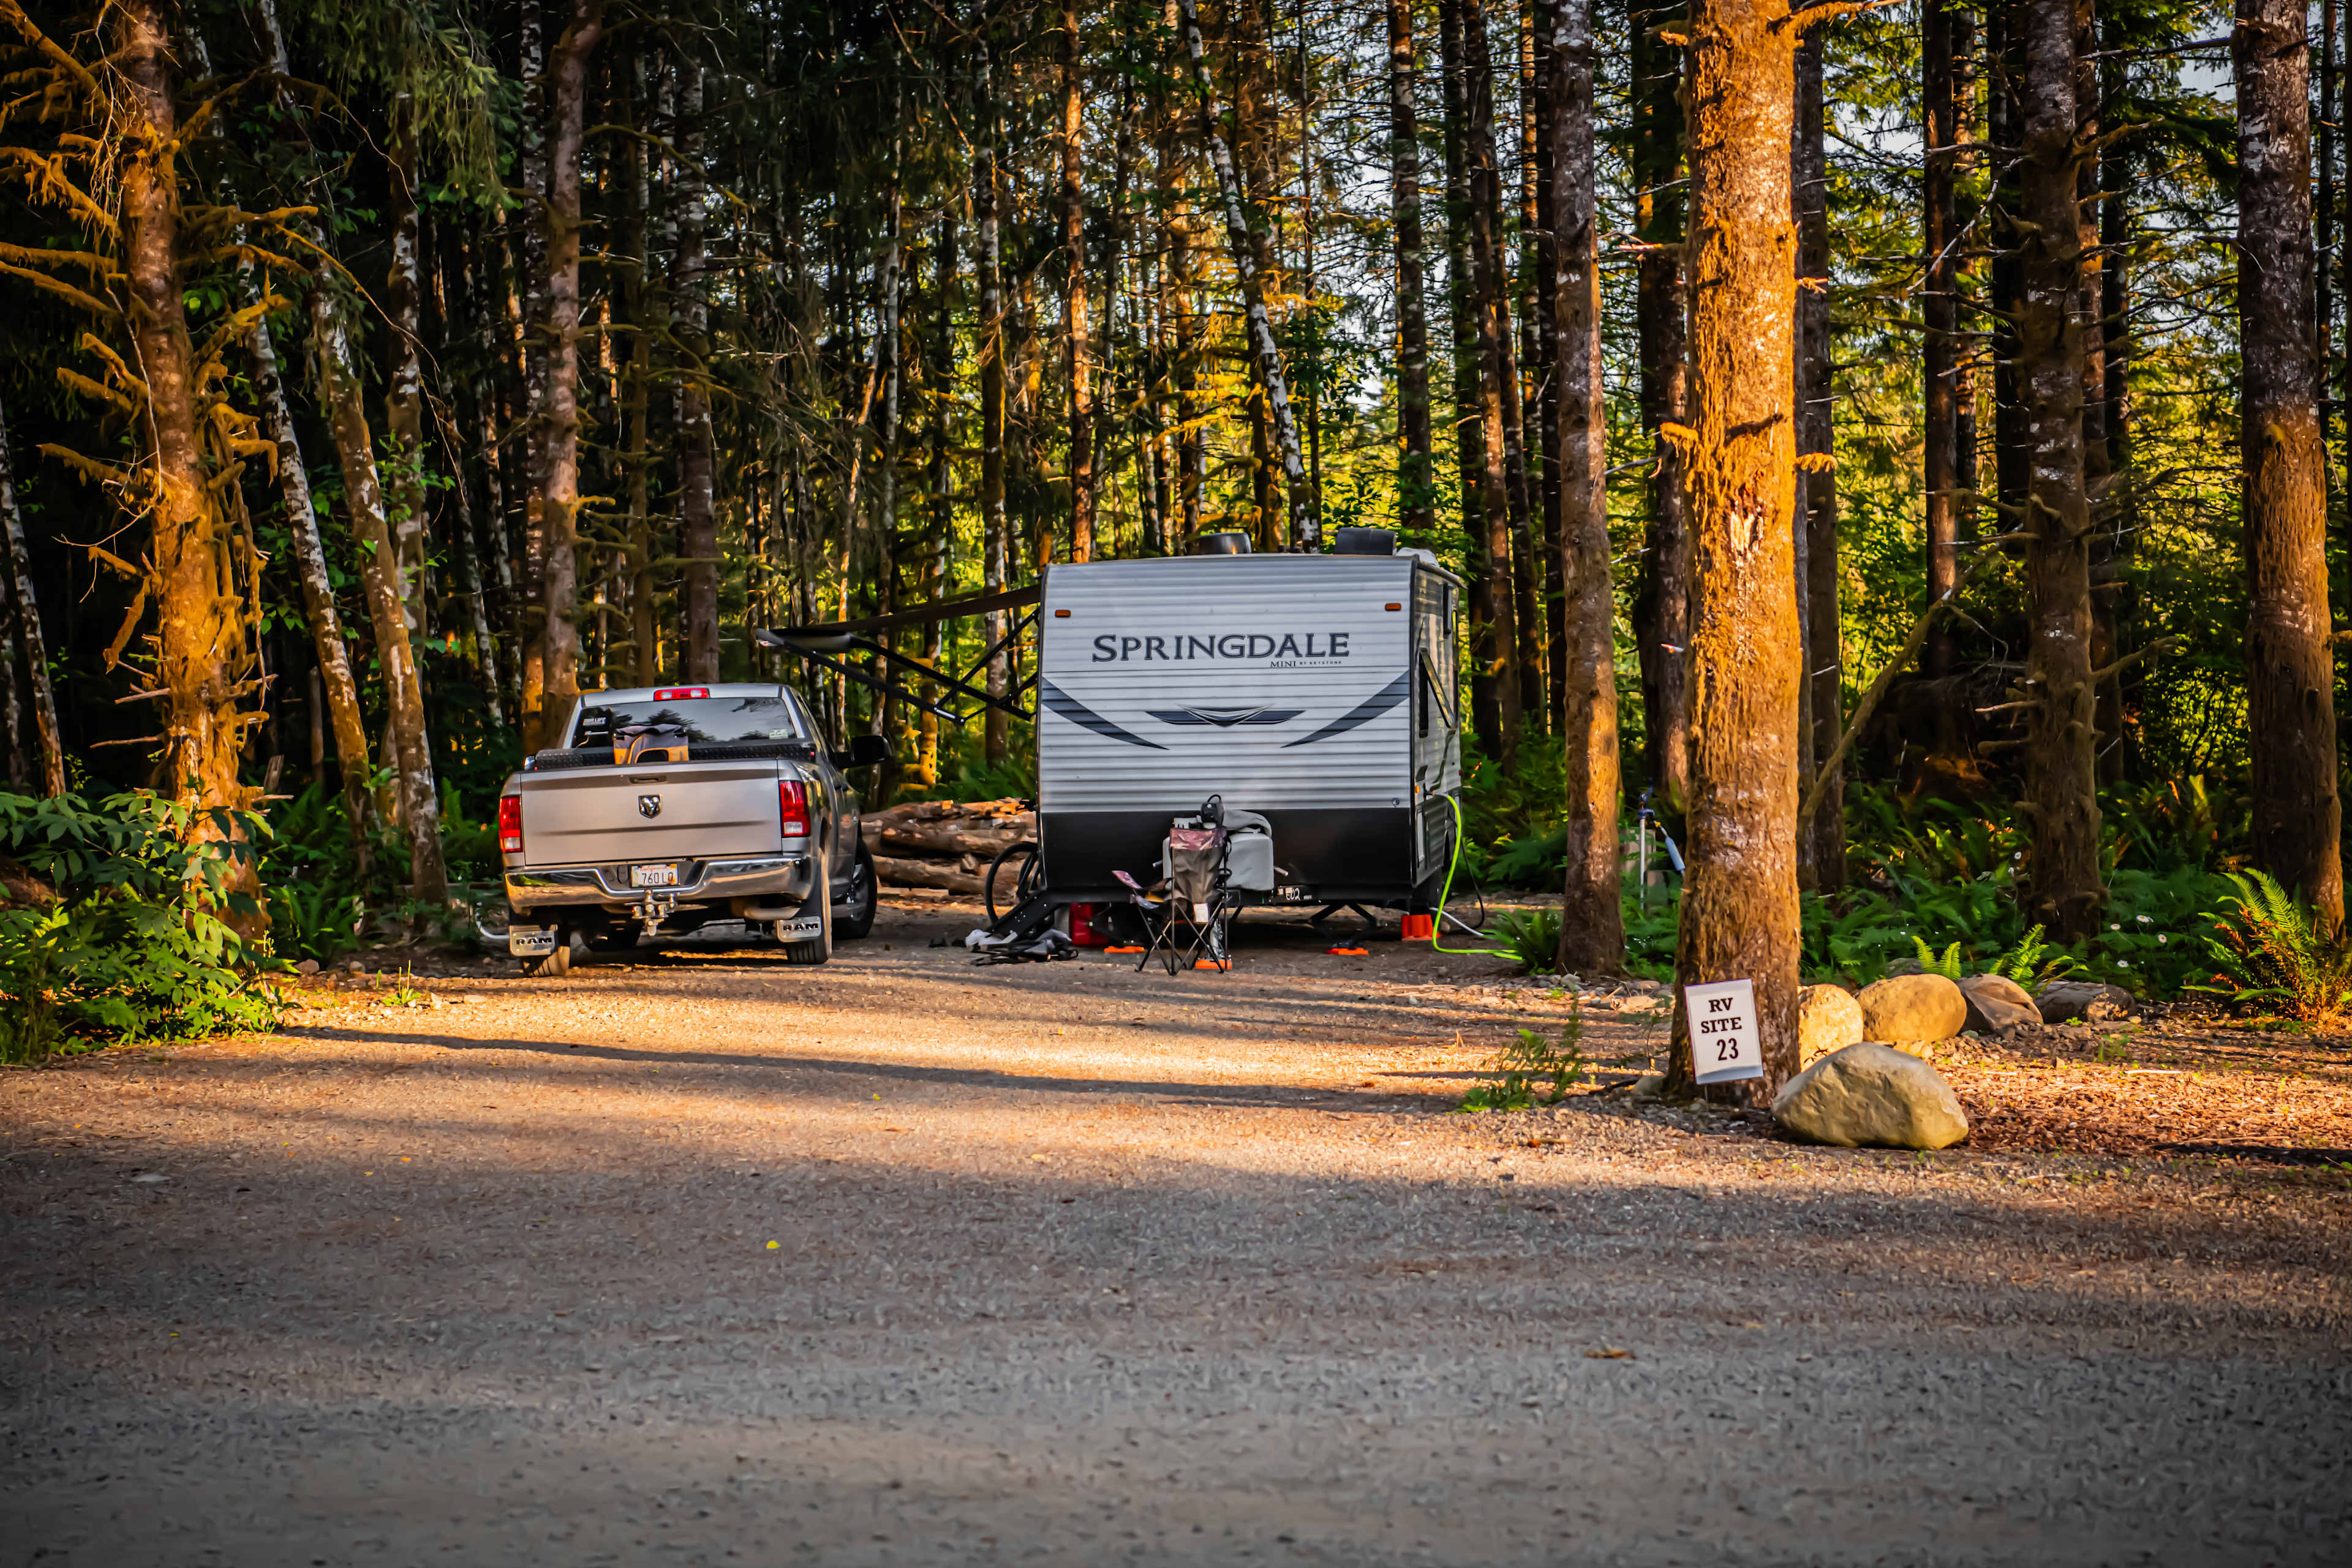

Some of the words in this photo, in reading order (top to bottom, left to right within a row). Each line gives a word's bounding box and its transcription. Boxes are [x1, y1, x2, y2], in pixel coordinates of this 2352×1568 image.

[1091, 632, 1350, 663] SPRINGDALE
[516, 937, 552, 946] RAM
[1708, 997, 1733, 1012] RV
[1700, 1016, 1742, 1034] SITE
[1717, 1038, 1739, 1061] 23
